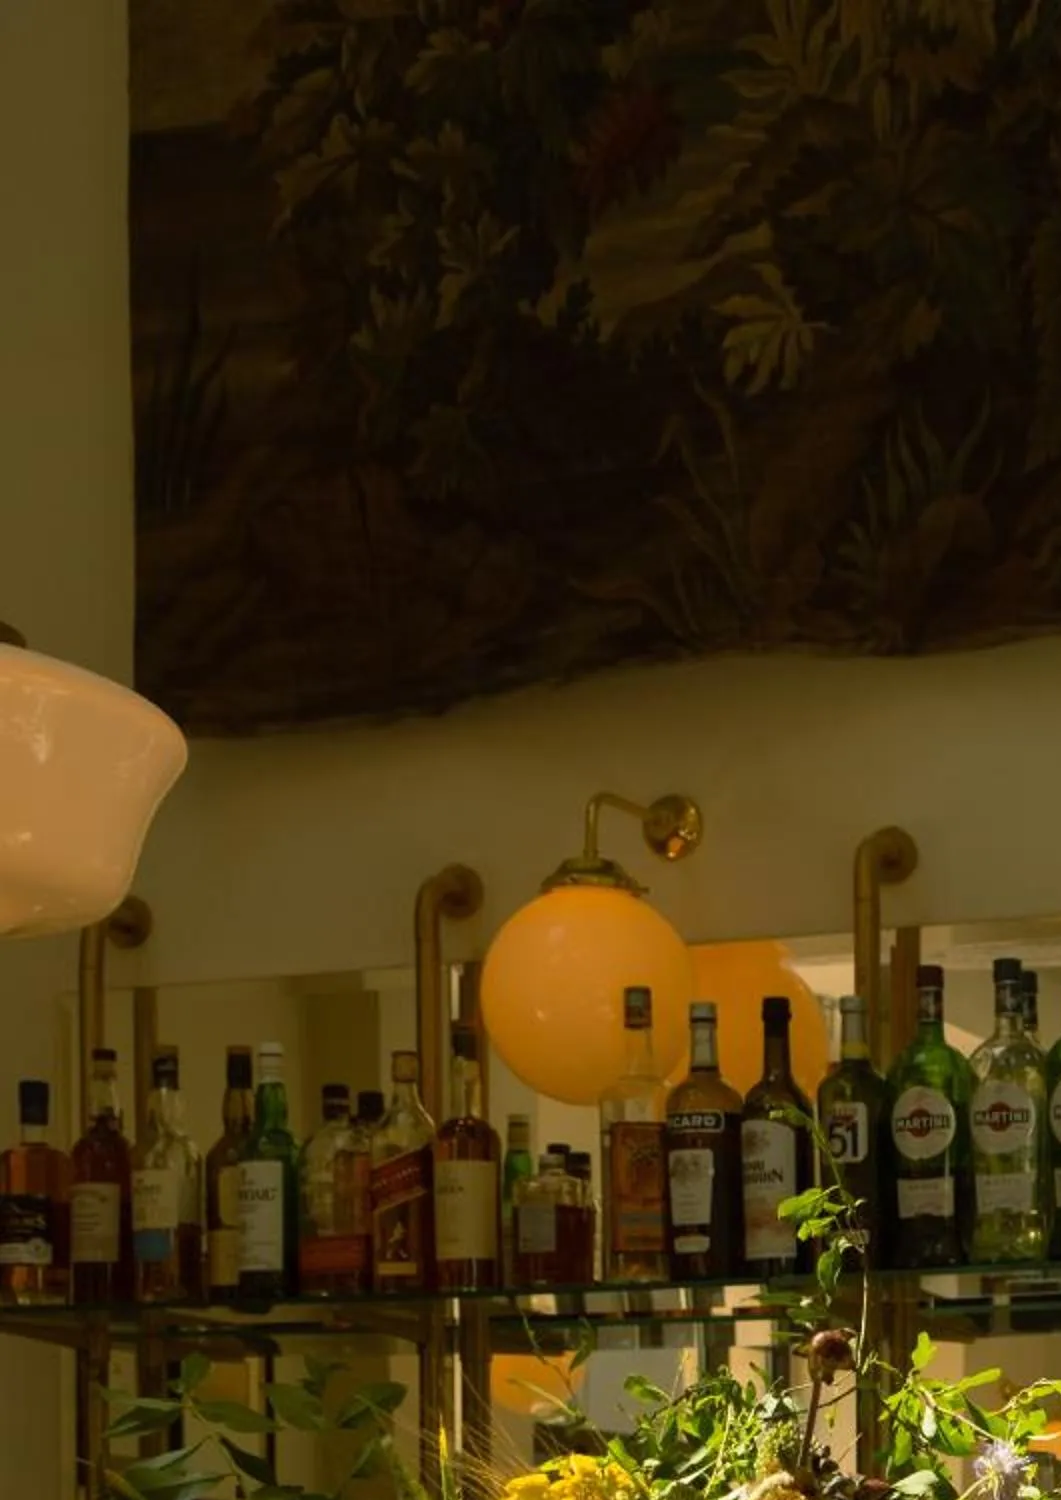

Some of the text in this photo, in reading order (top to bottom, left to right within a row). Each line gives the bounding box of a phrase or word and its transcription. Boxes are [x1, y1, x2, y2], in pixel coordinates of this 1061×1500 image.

[895, 1114, 950, 1133] MARTINI
[974, 1108, 1030, 1126] MARTINI
[828, 1119, 859, 1158] 51
